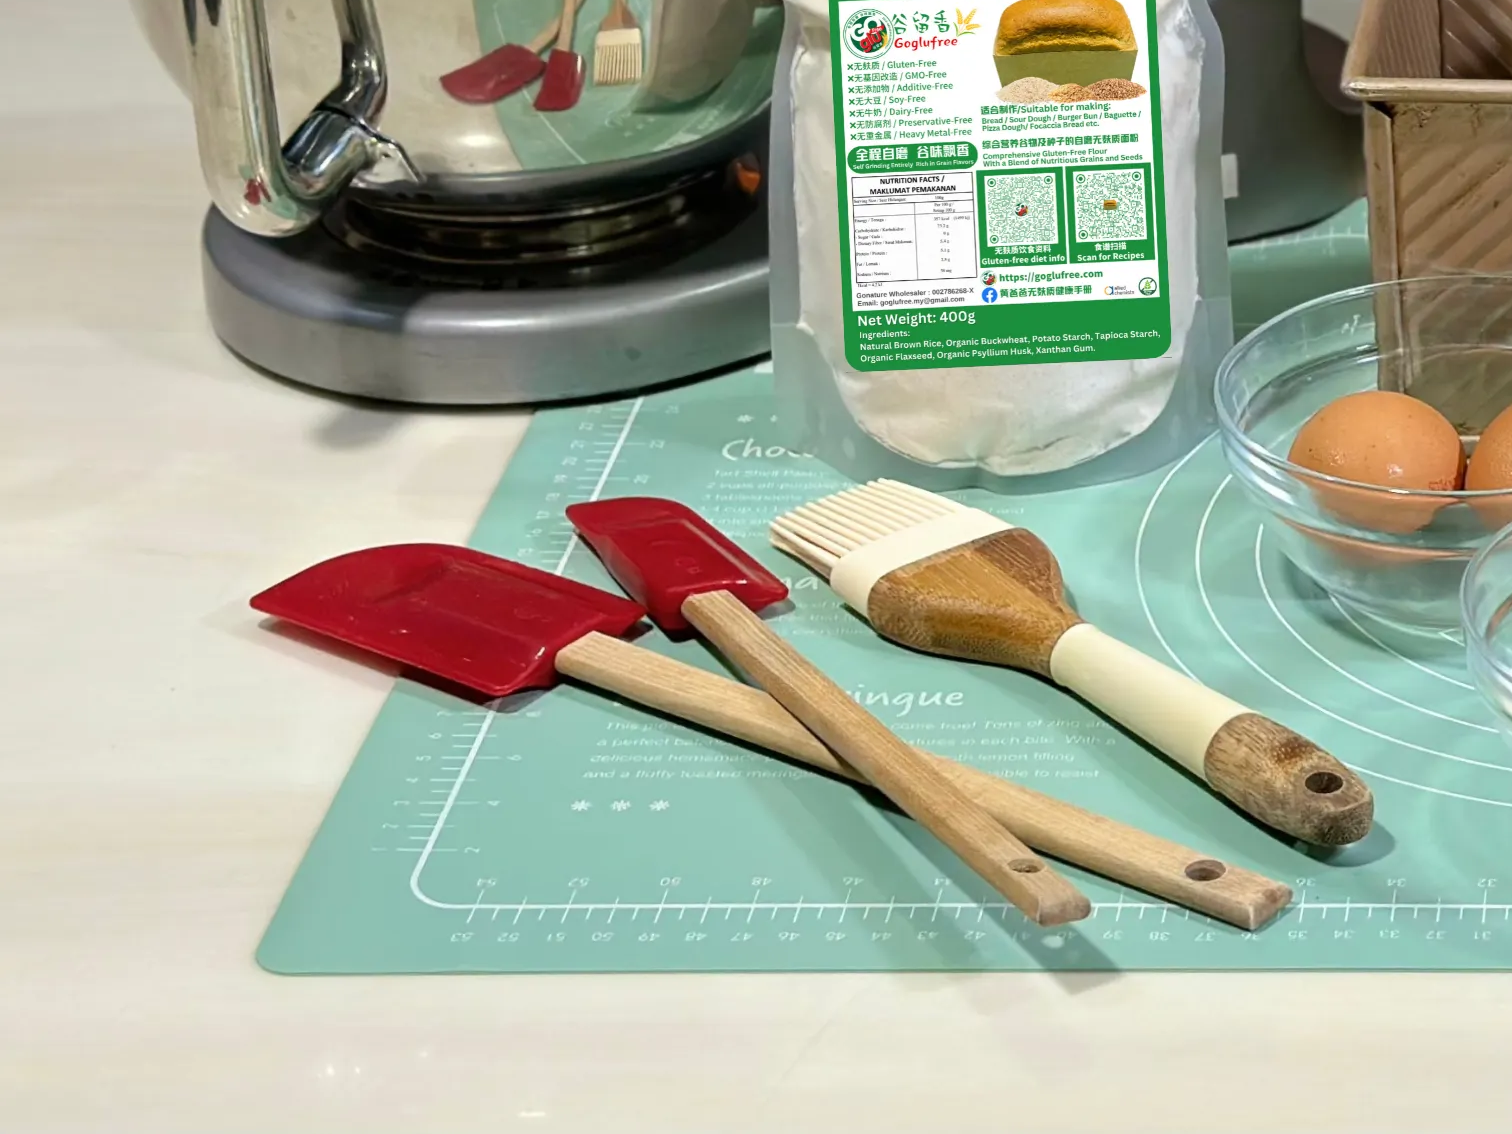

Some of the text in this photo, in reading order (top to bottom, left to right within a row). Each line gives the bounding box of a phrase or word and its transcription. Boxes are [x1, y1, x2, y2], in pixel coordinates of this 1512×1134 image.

[894, 36, 958, 51] Goglufree
[887, 60, 937, 69] Gluten-Free
[905, 71, 947, 79] GMO-Free
[897, 82, 953, 91] Additive-Free
[889, 95, 926, 105] Soy-Free
[889, 107, 933, 116] Dairy-Free
[1060, 103, 1074, 111] for
[1076, 102, 1111, 112] making:
[899, 117, 973, 126] Preservative-Free
[1028, 115, 1051, 123] Dough
[1057, 114, 1082, 122] Burger
[1104, 112, 1137, 120] Baguette
[1030, 122, 1062, 130] Focaccia
[899, 131, 925, 139] Heavy
[927, 128, 972, 137] Metal-Free
[982, 151, 1041, 160] Comprehensive
[1042, 149, 1086, 157] Gluten-Free
[981, 254, 1065, 265] Gluten-free diet info
[1113, 252, 1144, 261] Recipes
[999, 271, 1103, 283] https://goglufree.com
[858, 311, 976, 327] Net Weight: 400g
[860, 330, 910, 340] Ingredients:
[860, 342, 892, 350] Natural
[923, 340, 944, 348] Rice,
[946, 338, 979, 348] Organic
[981, 336, 1030, 345] Buckwheat,
[1063, 333, 1093, 341] Starch,
[1095, 332, 1128, 341] Tapioca
[1130, 330, 1160, 338] Starch,
[860, 354, 893, 363] Organic
[895, 352, 935, 360] Flaxseed,
[937, 350, 970, 360] Organic
[972, 349, 1008, 358] Psyllium
[1010, 347, 1033, 355] Husk,
[1036, 346, 1071, 354] Xanthan
